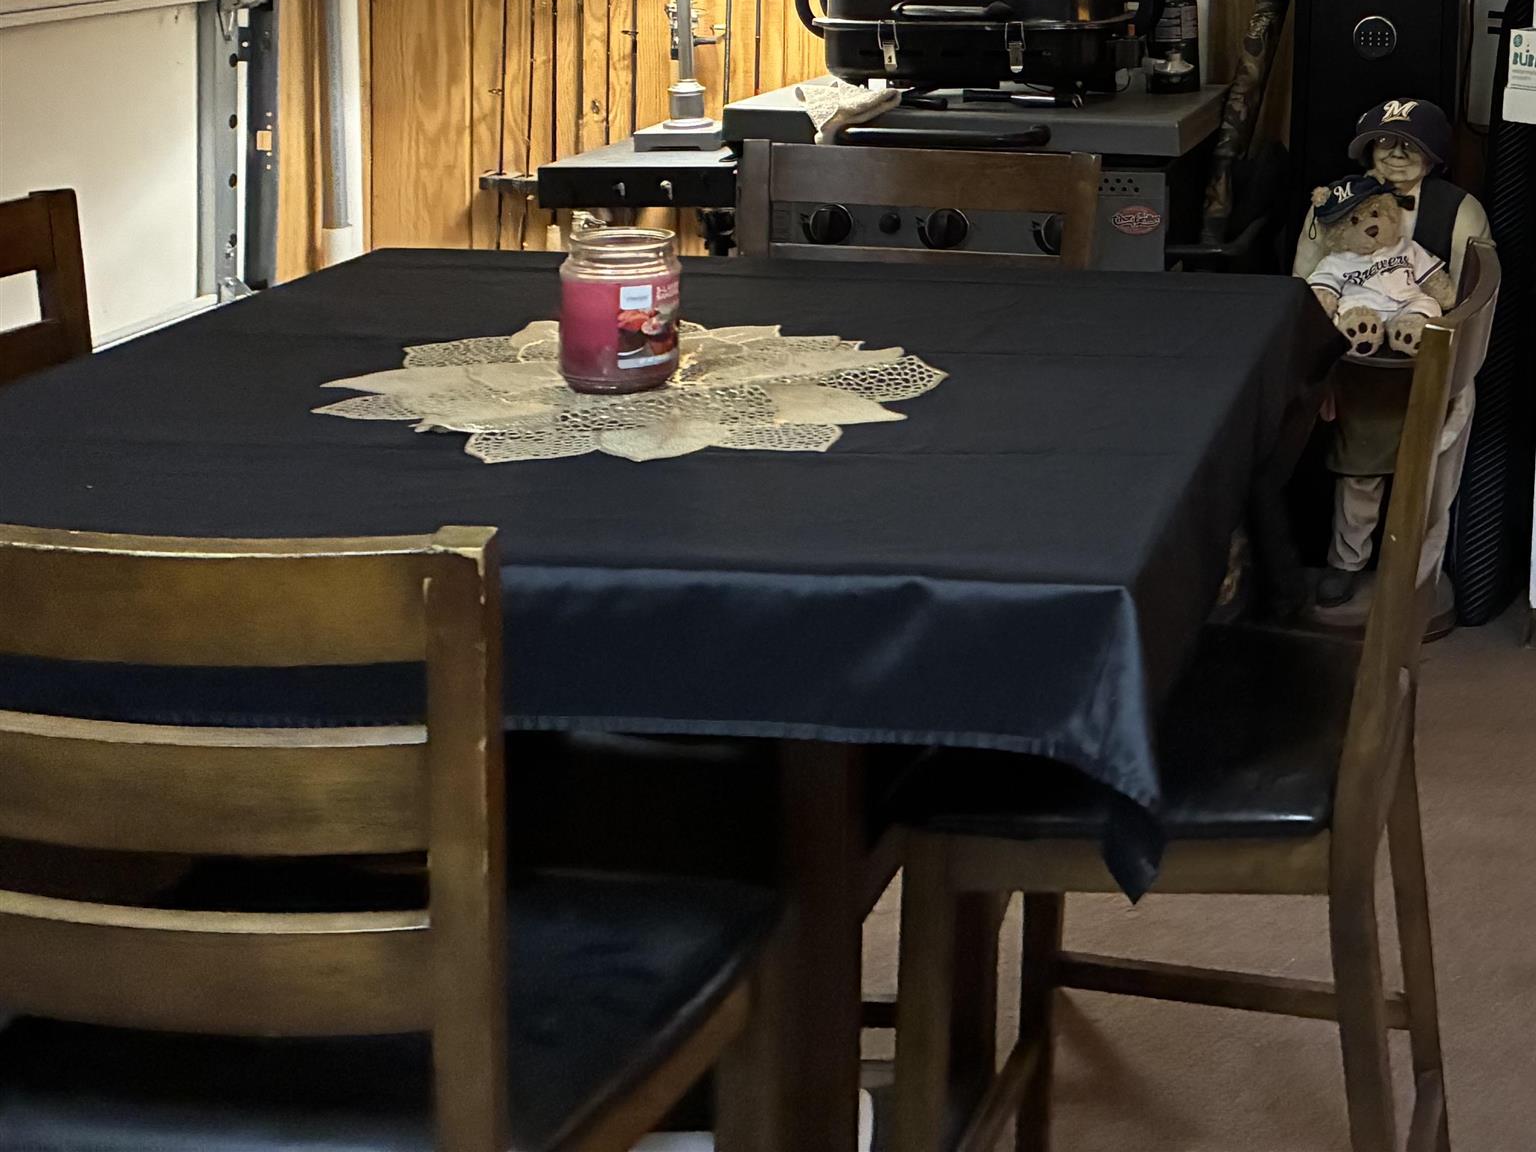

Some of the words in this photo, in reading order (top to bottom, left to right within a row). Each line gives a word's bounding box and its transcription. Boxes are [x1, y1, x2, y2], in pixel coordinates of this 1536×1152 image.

[1379, 100, 1419, 124] M
[1333, 181, 1355, 203] M
[1342, 255, 1410, 287] Brewers
